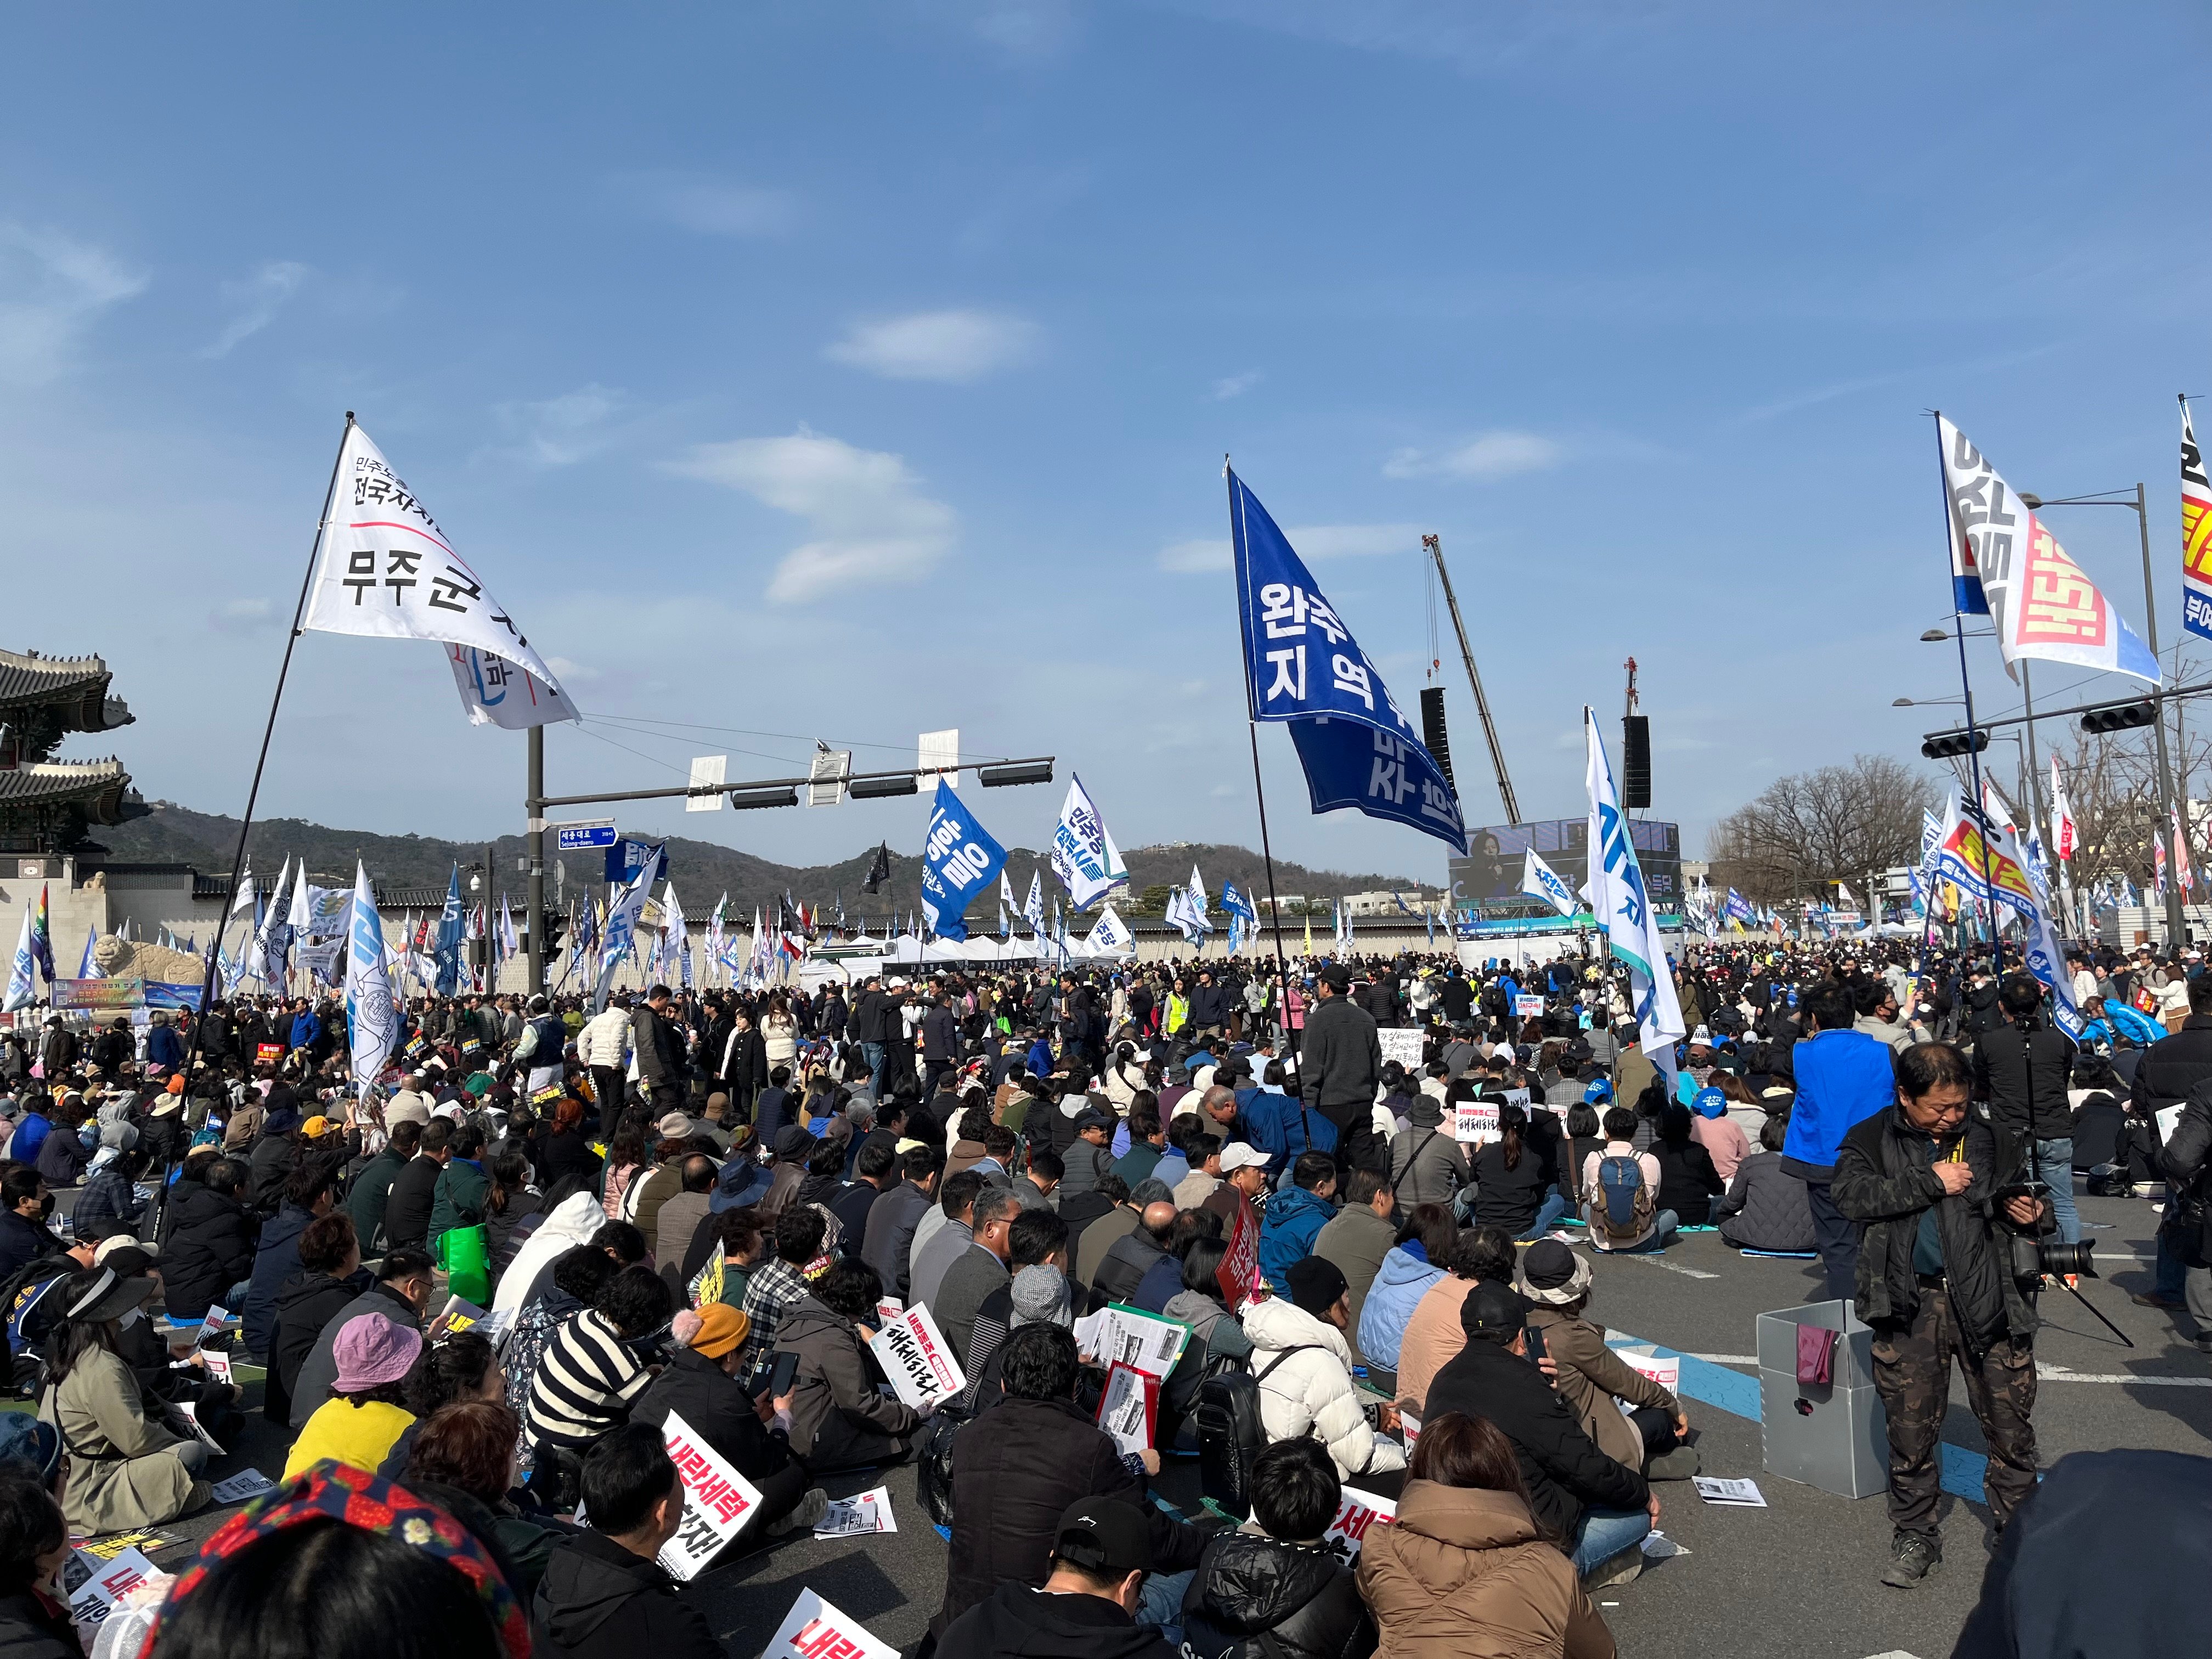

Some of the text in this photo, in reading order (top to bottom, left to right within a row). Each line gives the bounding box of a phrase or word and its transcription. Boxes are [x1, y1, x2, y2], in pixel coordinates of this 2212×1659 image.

[355, 477, 450, 544] 전국자치
[561, 830, 591, 840] 세종대로
[1458, 1117, 1499, 1132] 해체하라
[1459, 1108, 1484, 1116] 내란동조
[907, 1312, 935, 1355] 내란동조
[887, 1324, 939, 1397] 해체하라
[665, 1435, 751, 1525] 내란세력
